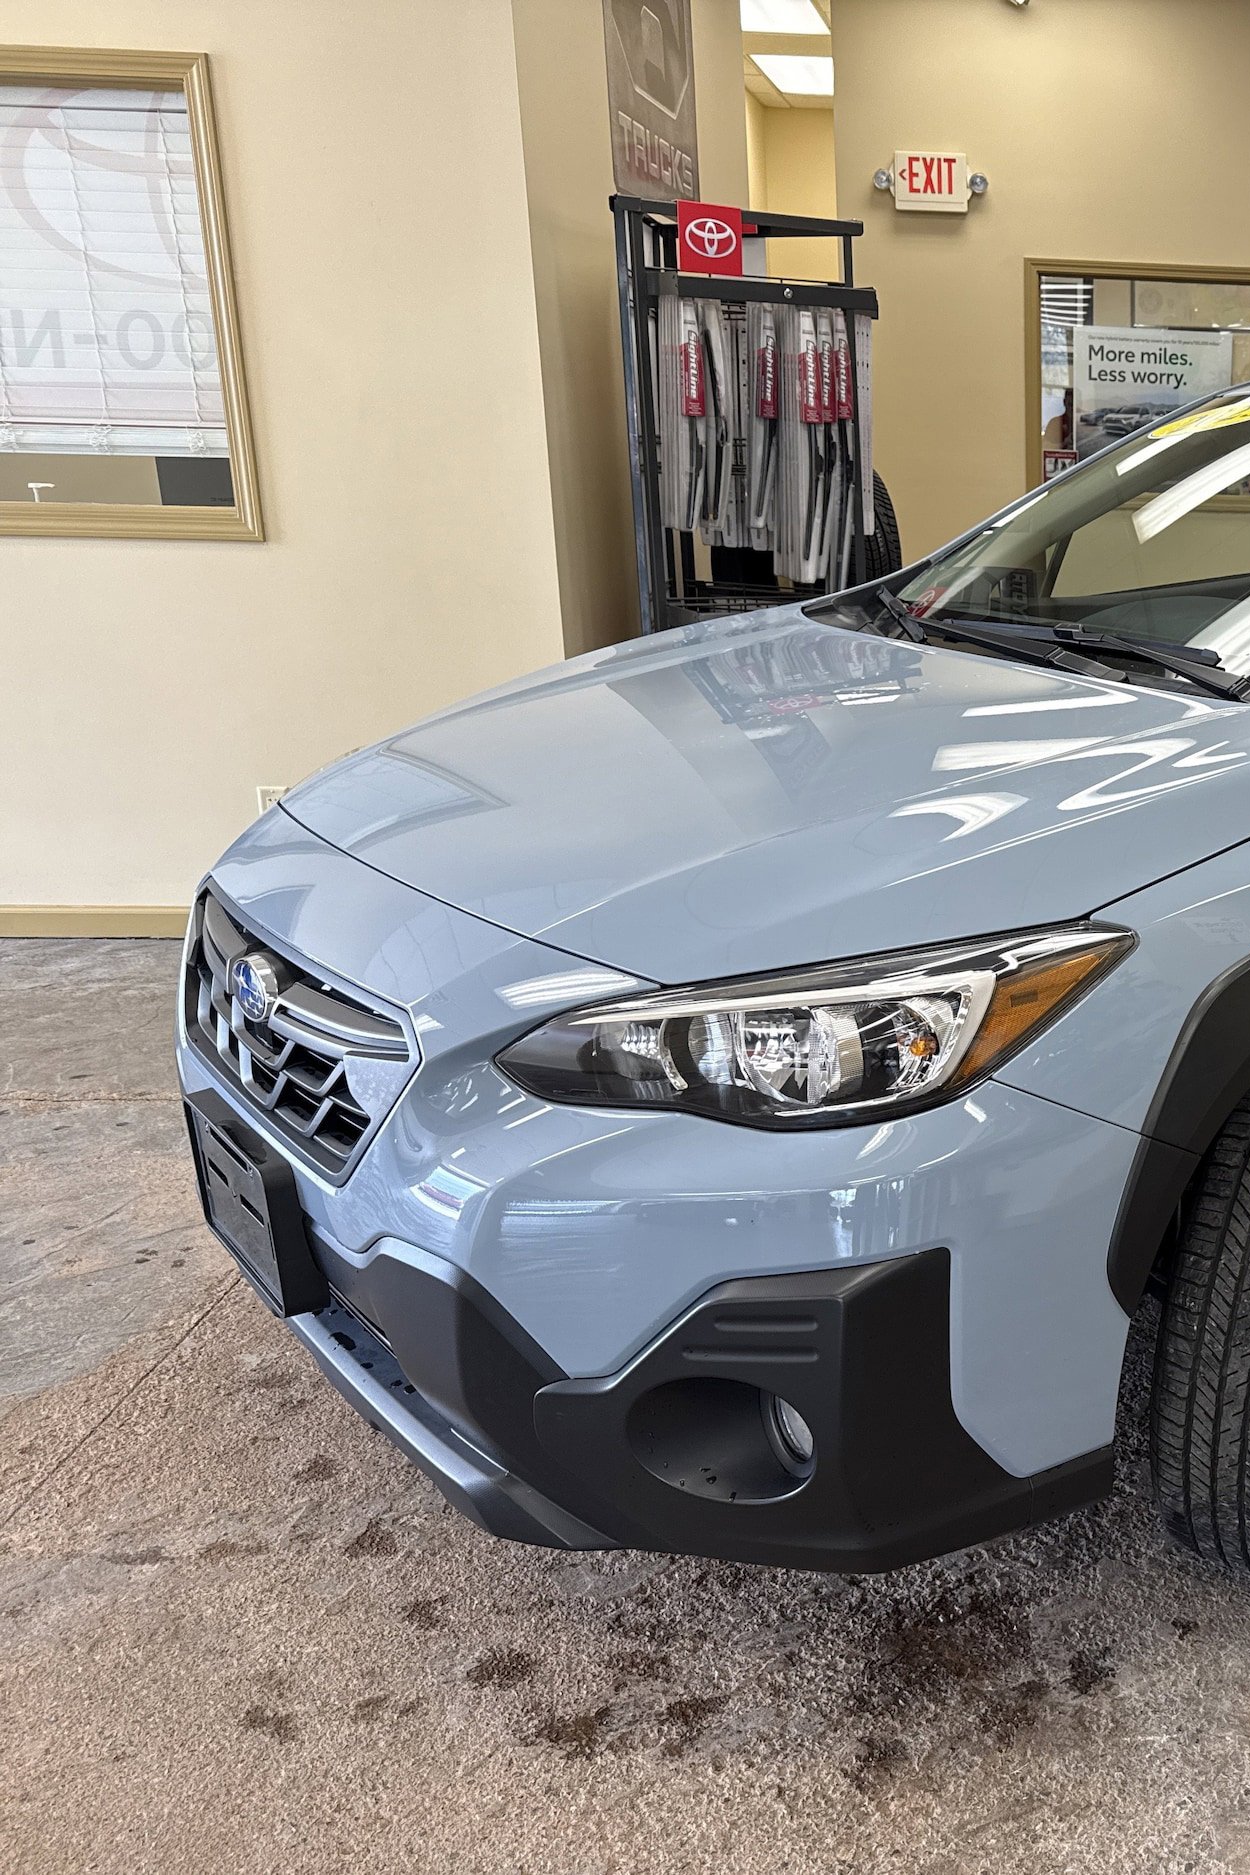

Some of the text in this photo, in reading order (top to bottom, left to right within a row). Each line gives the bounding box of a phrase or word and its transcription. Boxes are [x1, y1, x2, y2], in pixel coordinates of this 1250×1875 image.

[617, 110, 693, 197] TRUCKS
[908, 156, 957, 195] EXIT
[687, 330, 699, 399] SightLine
[765, 335, 775, 401] SightLine
[806, 340, 816, 407] SightLine
[1088, 344, 1193, 366] More miles.
[1088, 364, 1187, 389] Less worry.
